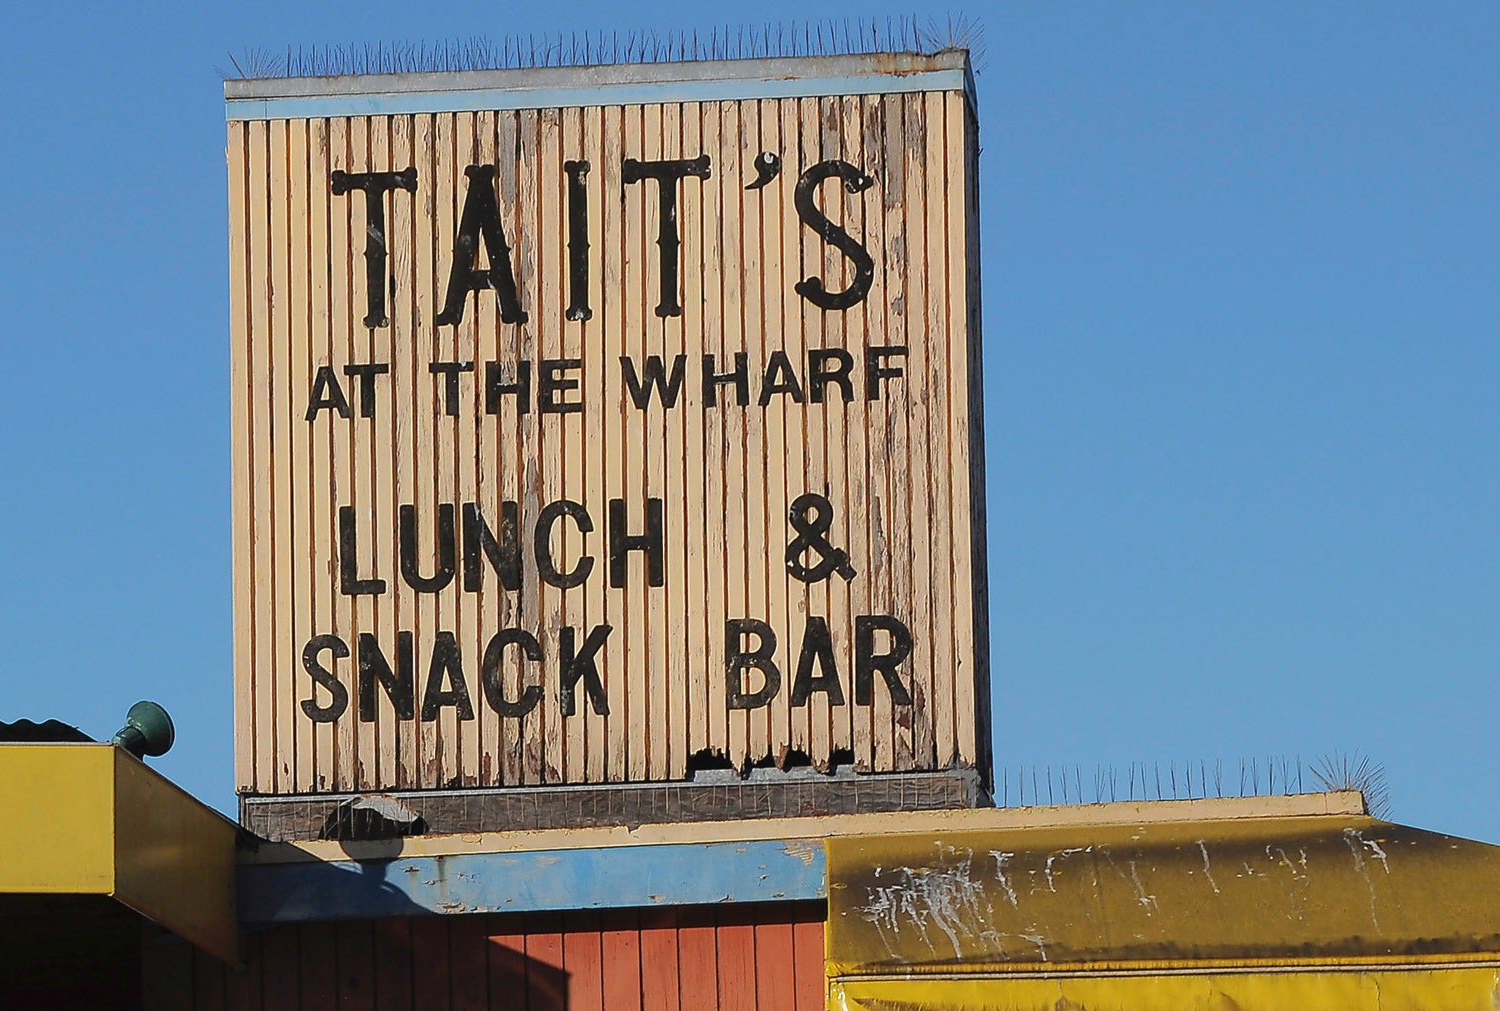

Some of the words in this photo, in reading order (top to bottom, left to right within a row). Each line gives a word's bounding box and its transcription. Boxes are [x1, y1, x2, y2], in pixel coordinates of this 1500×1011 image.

[331, 151, 875, 329] TAIT'S
[305, 362, 390, 421] AT
[428, 358, 586, 417] THE
[618, 345, 909, 409] WHARF
[339, 498, 665, 596] LUNCH
[785, 491, 857, 586] &
[300, 624, 614, 724] SNACK
[724, 614, 915, 711] BAR
